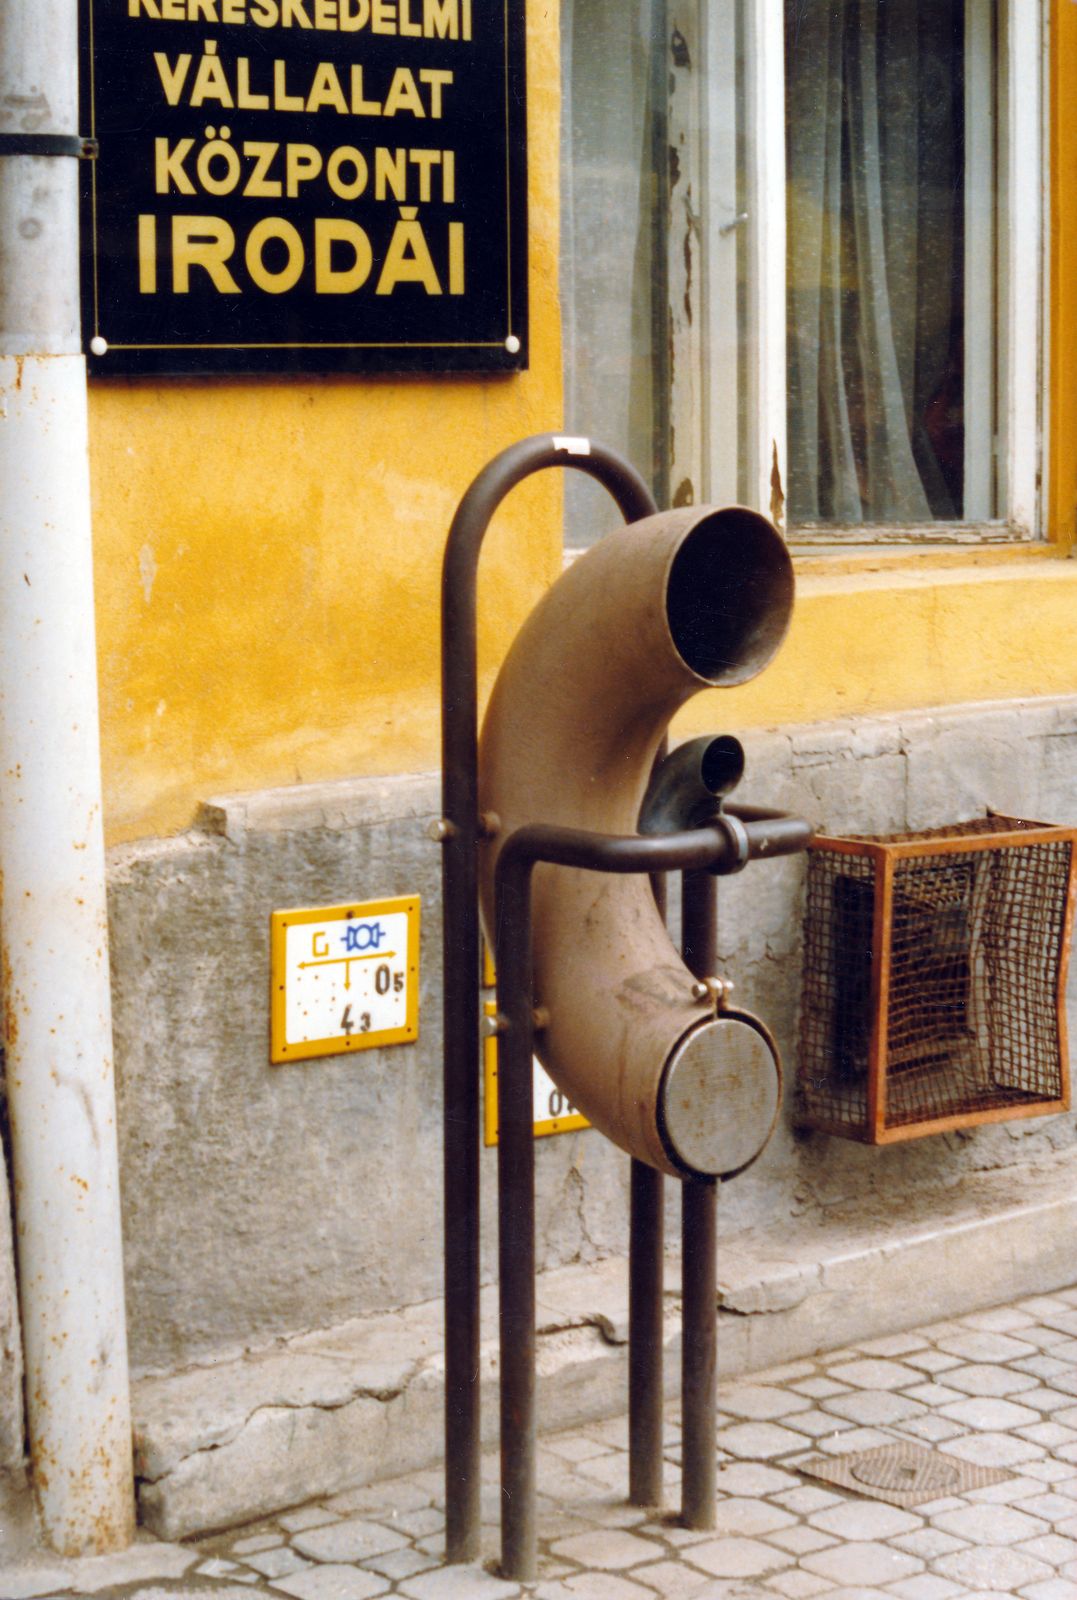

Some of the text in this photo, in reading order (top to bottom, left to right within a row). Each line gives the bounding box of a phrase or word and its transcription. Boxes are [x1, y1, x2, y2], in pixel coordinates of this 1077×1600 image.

[153, 40, 454, 119] VÁLLALAT
[154, 125, 455, 203] KÖZPONTI
[138, 206, 465, 295] IRODÁI
[312, 931, 329, 957] G
